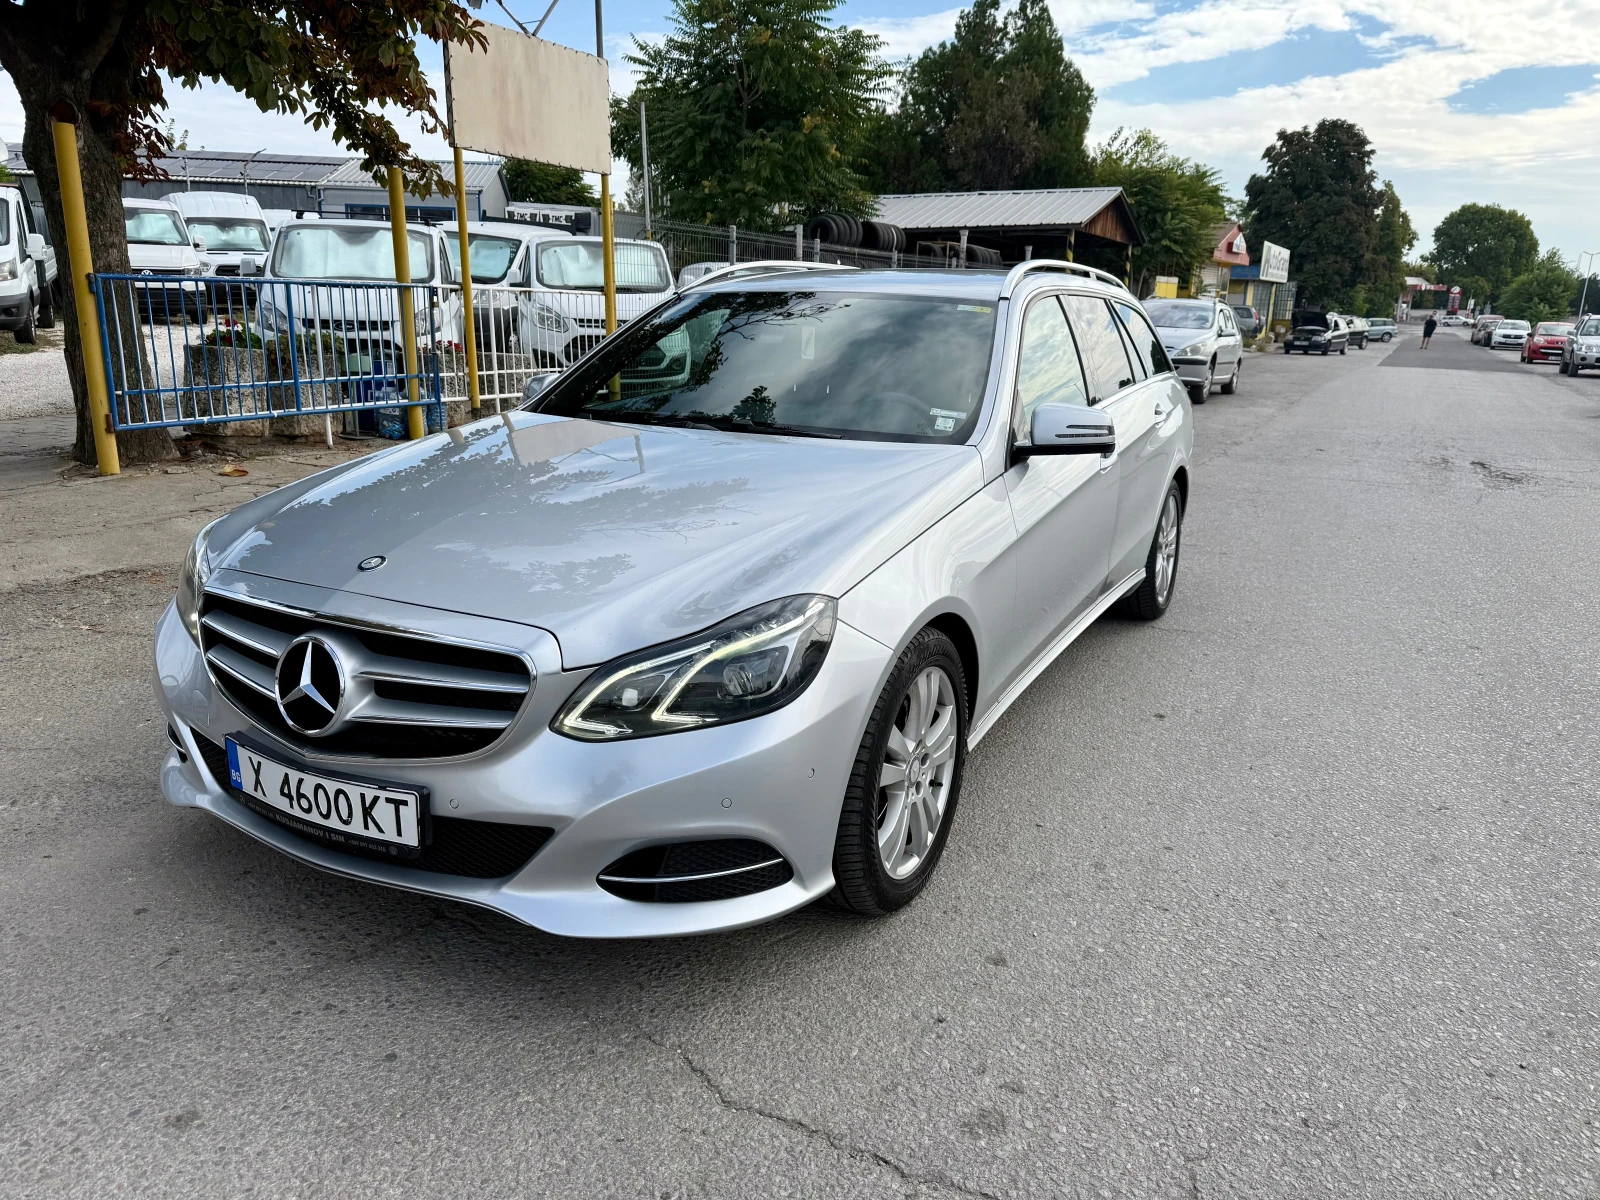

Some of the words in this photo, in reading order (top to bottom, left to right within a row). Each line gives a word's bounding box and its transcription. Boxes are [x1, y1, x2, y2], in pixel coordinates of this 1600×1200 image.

[231, 769, 241, 783] BG
[248, 755, 268, 798] X
[330, 833, 345, 843] SIN
